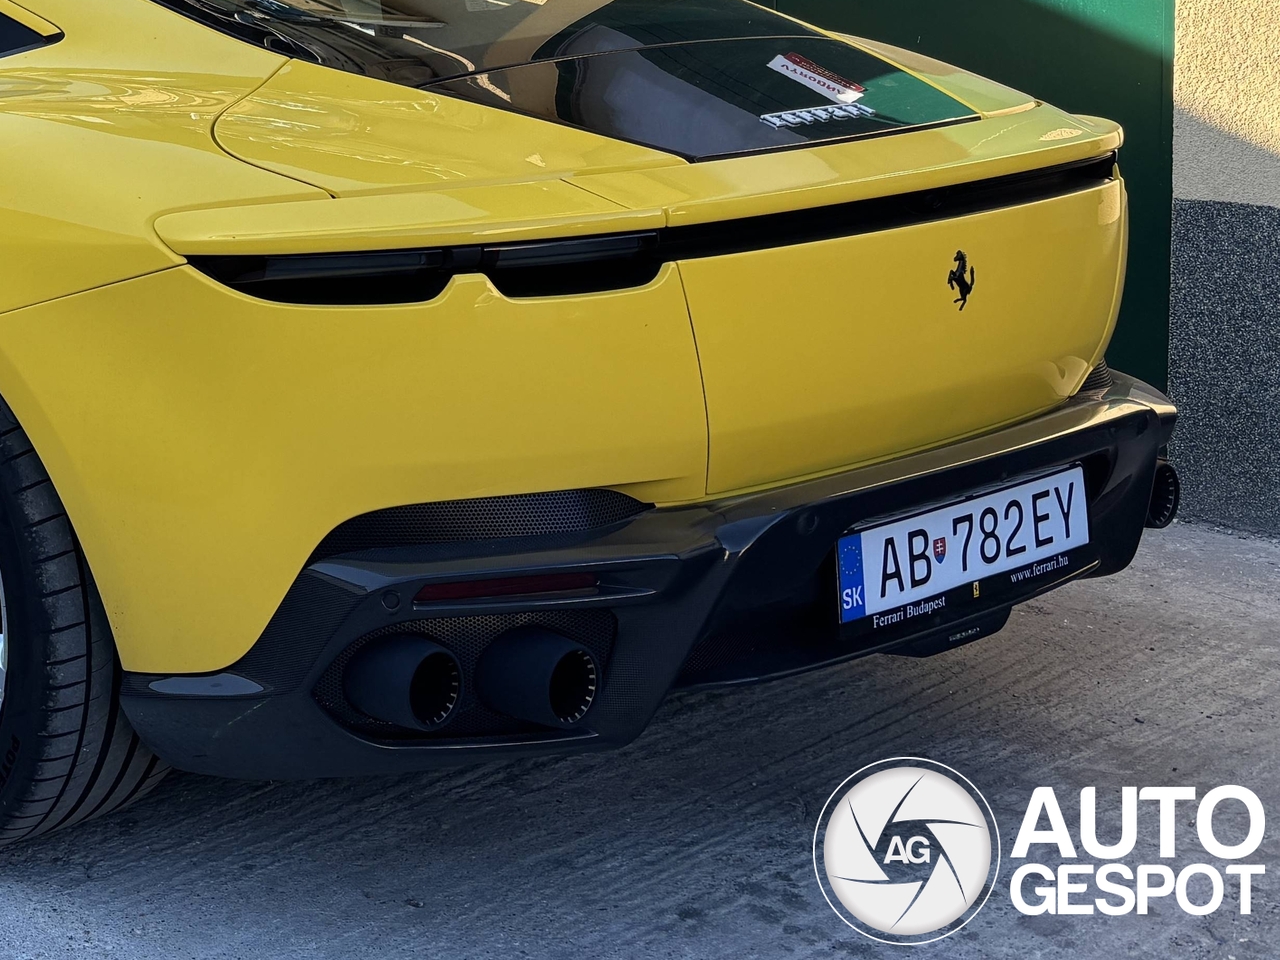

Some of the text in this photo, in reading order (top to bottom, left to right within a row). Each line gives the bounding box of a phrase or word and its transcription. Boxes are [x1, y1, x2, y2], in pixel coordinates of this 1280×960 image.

[880, 481, 1074, 598] AB 782EY
[1010, 554, 1070, 584] www.ferrari.hu
[842, 585, 864, 610] SK
[873, 596, 946, 628] Ferrari Budapest
